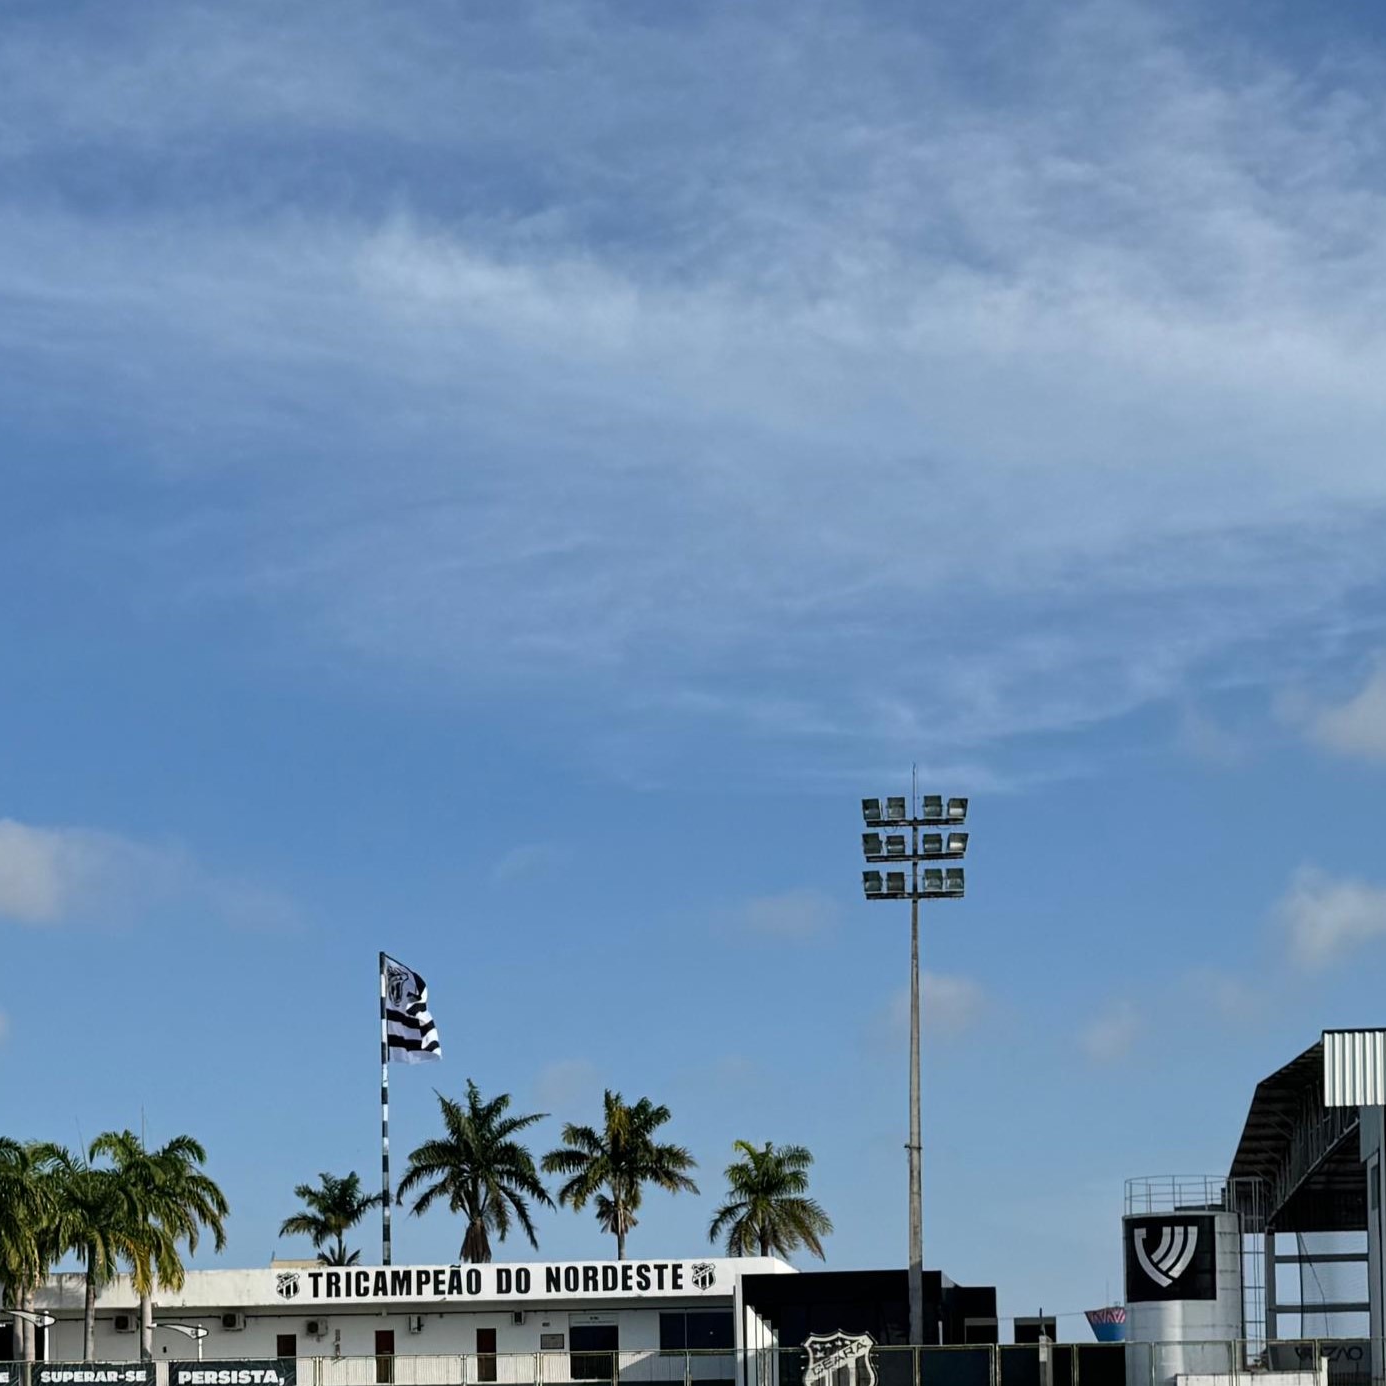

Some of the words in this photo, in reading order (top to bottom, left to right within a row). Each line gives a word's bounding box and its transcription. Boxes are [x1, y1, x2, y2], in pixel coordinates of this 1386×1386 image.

[308, 1264, 482, 1298] TRICAMPEÃO
[497, 1267, 531, 1294] DO
[546, 1264, 683, 1292] NORDESTE
[40, 1370, 146, 1383] SUPERAR-SE
[178, 1369, 285, 1386] PERSISTA,
